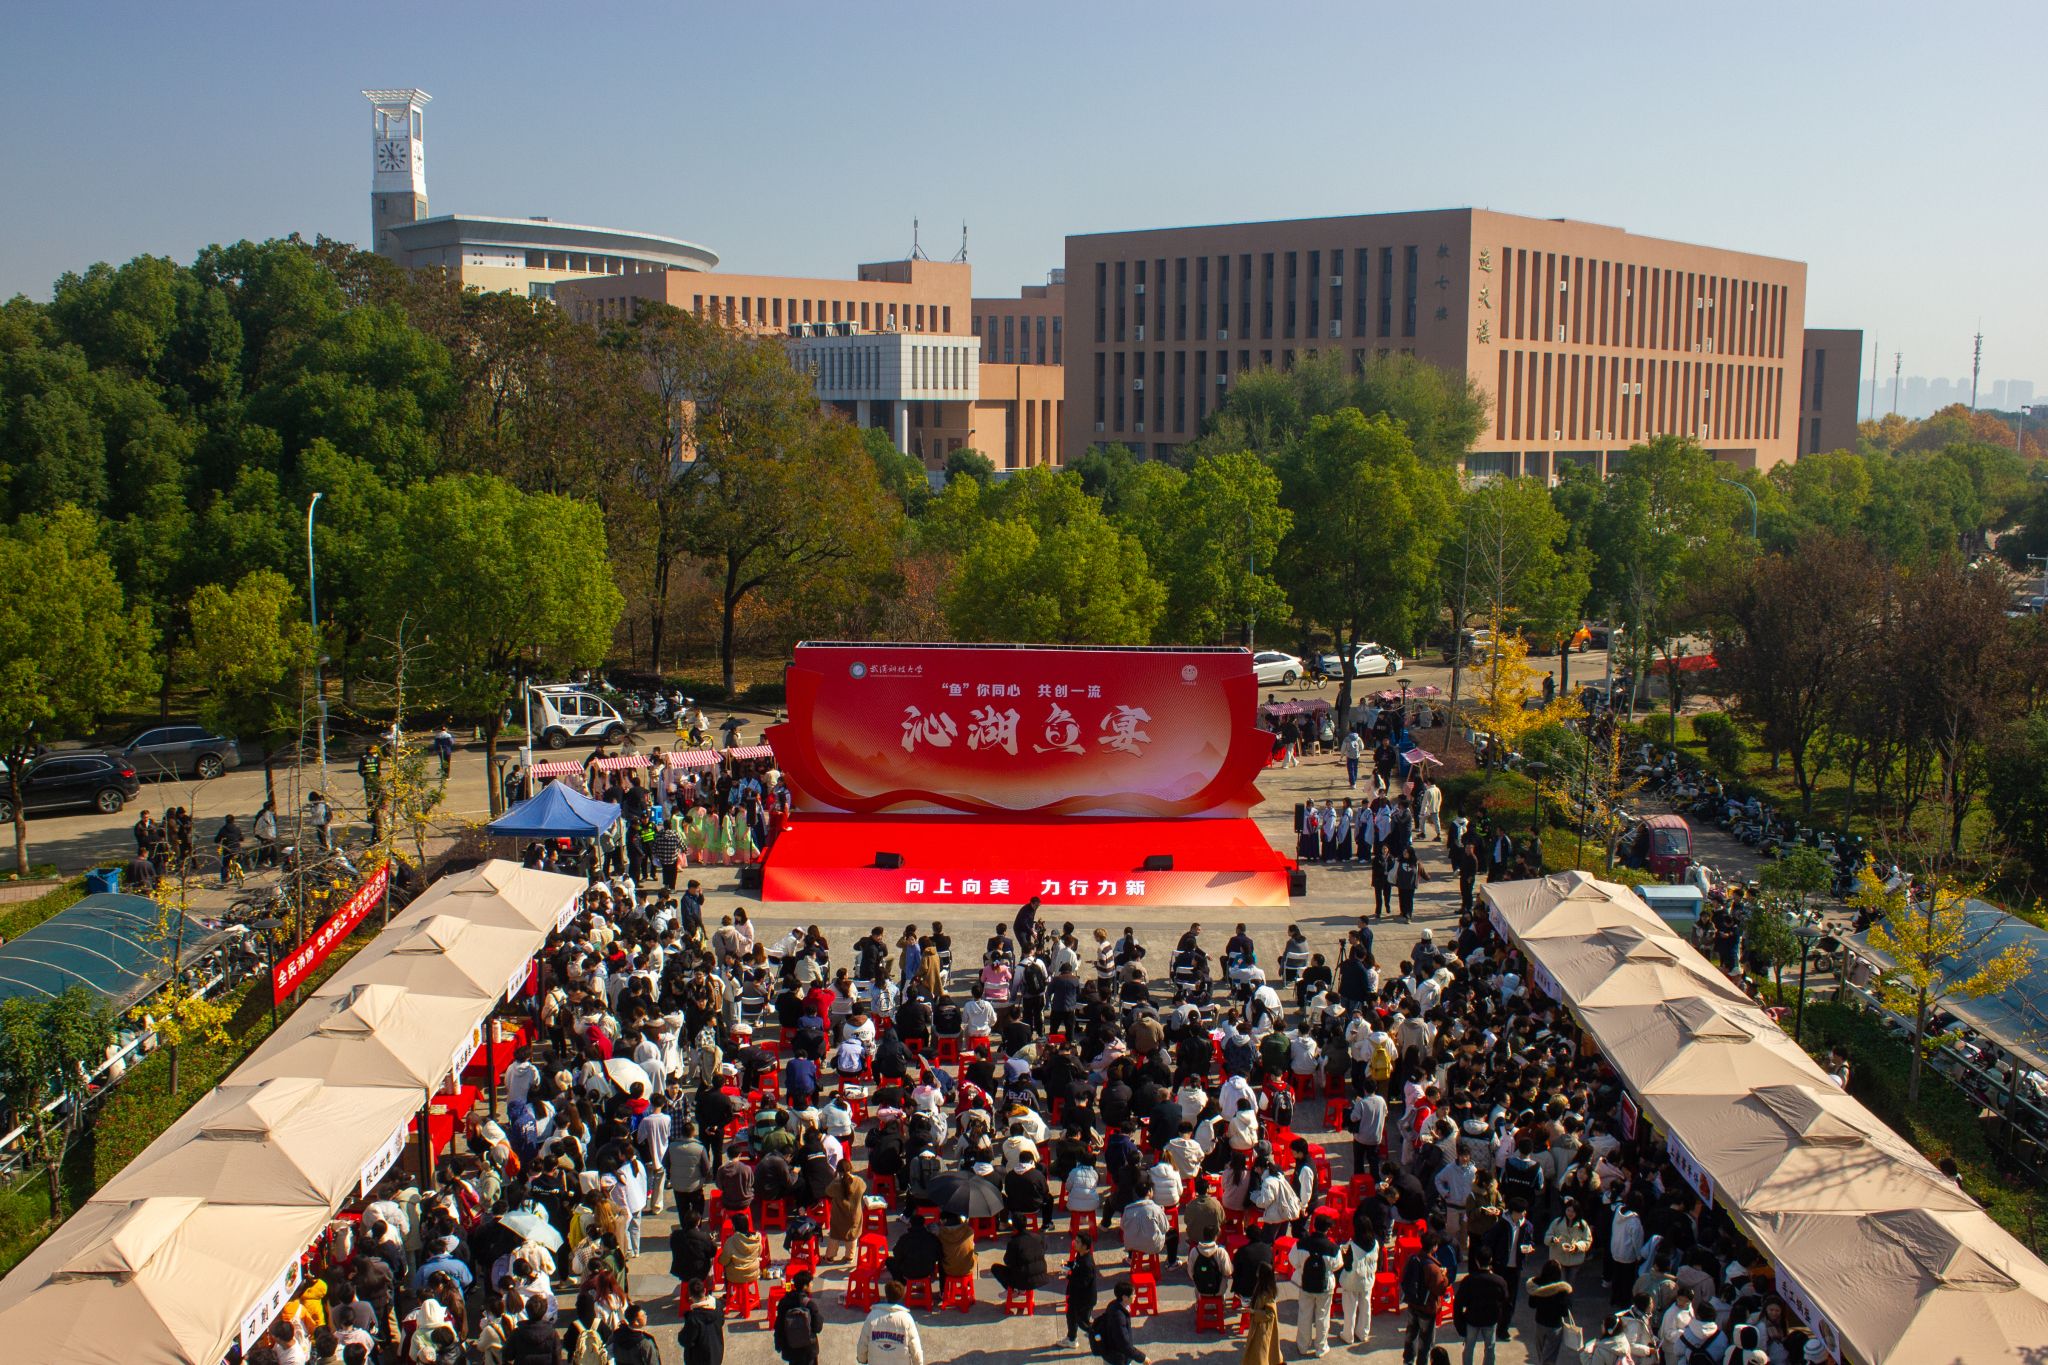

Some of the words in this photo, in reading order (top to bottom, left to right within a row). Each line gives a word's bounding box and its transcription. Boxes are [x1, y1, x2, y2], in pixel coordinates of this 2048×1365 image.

[1038, 684, 1102, 699] 共创一流
[904, 877, 1010, 896] 向上向美
[1040, 878, 1146, 897] 力行力新
